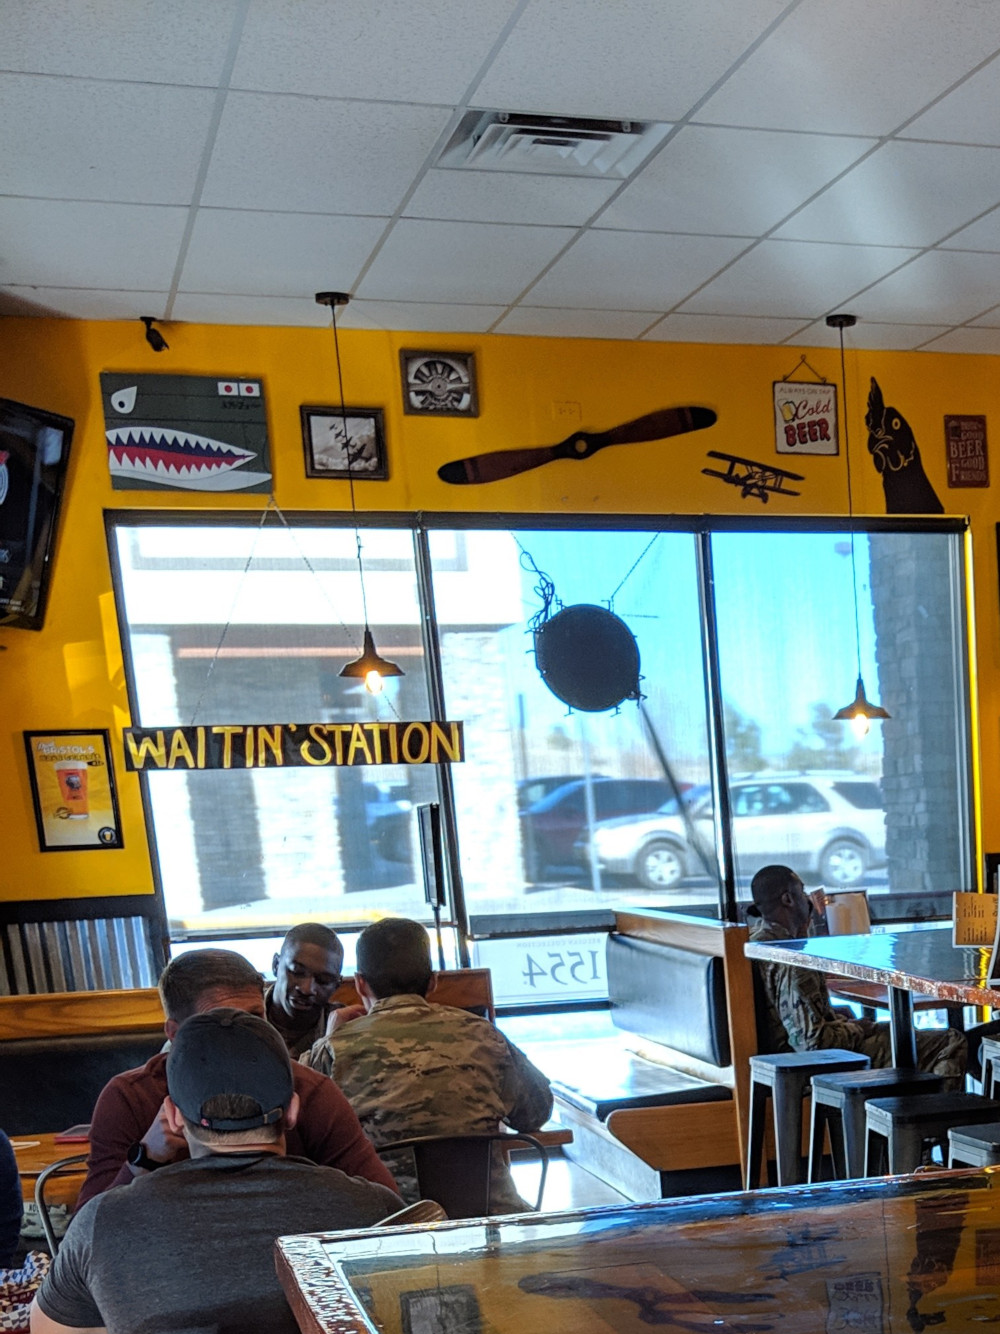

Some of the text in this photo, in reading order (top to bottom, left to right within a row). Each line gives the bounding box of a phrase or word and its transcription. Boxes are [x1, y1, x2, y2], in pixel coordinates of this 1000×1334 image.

[796, 398, 832, 419] Cold
[784, 418, 831, 447] BEER
[949, 440, 984, 458] BEER
[960, 456, 985, 470] GOOD
[126, 722, 461, 769] WAITIN' STATION
